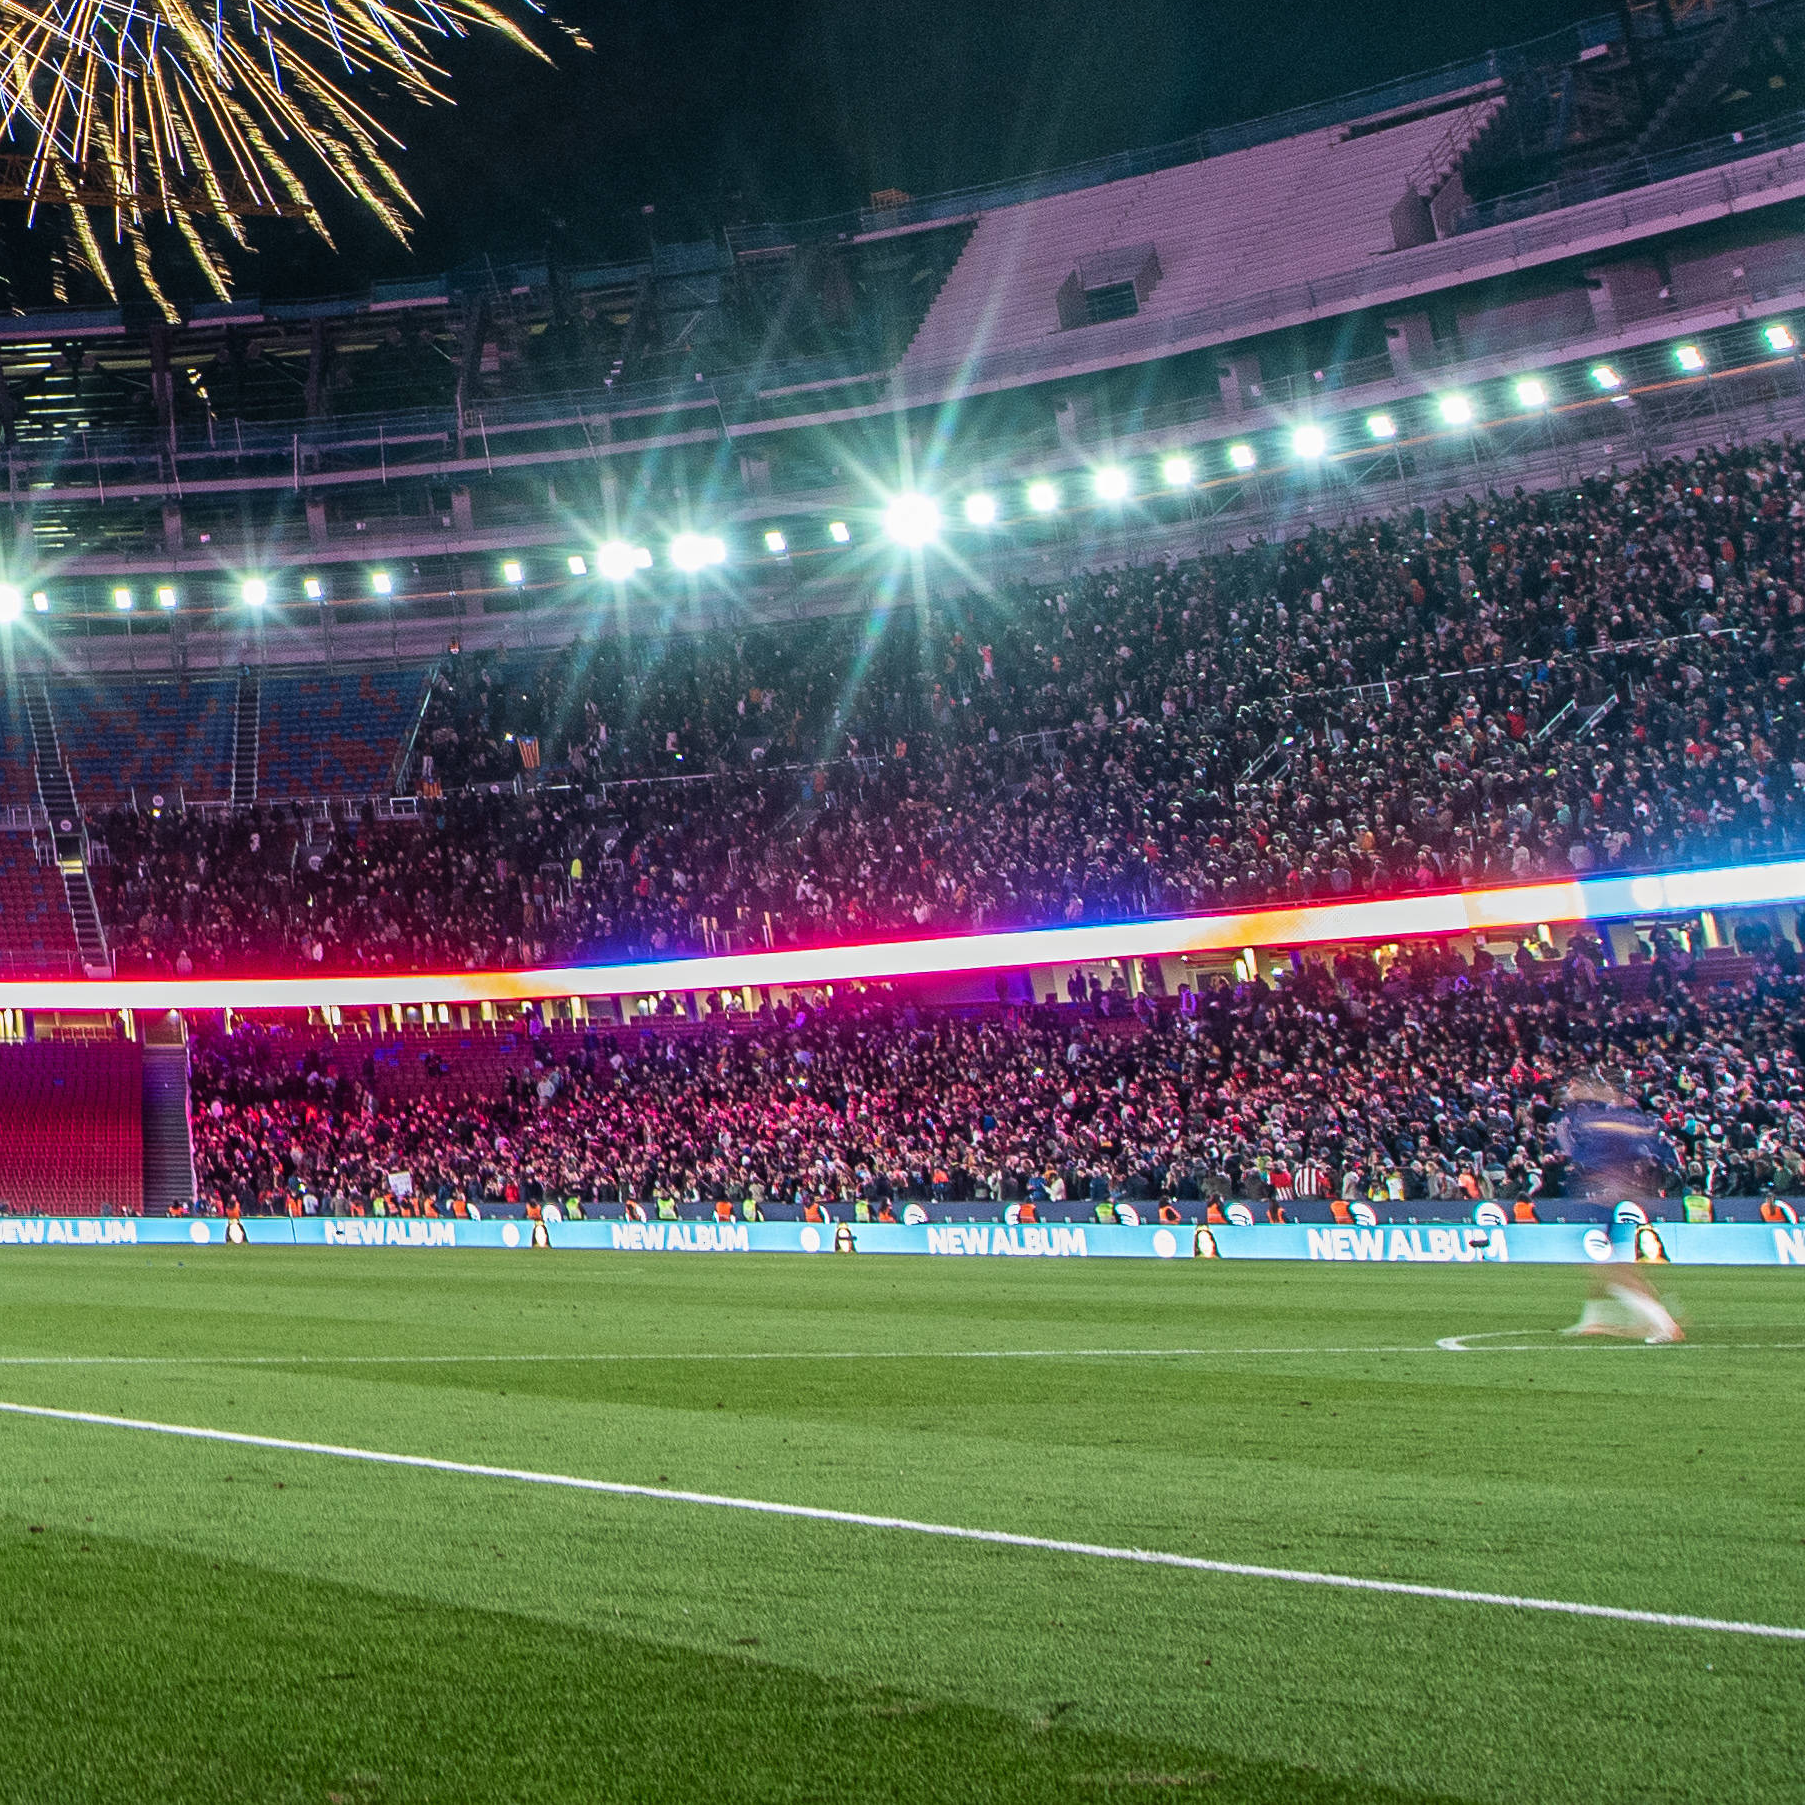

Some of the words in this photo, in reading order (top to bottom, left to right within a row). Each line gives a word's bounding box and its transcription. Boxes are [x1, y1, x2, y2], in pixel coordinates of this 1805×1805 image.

[46, 1220, 138, 1244] ALBUM
[324, 1220, 385, 1245] NEW
[386, 1220, 456, 1247] ALBUM
[611, 1223, 665, 1251] NEW
[666, 1224, 750, 1252] ALBUM
[927, 1227, 989, 1255] NEW
[991, 1228, 1088, 1257] ALBUM
[1307, 1228, 1384, 1261] NEW
[1388, 1229, 1510, 1262] ALBUM
